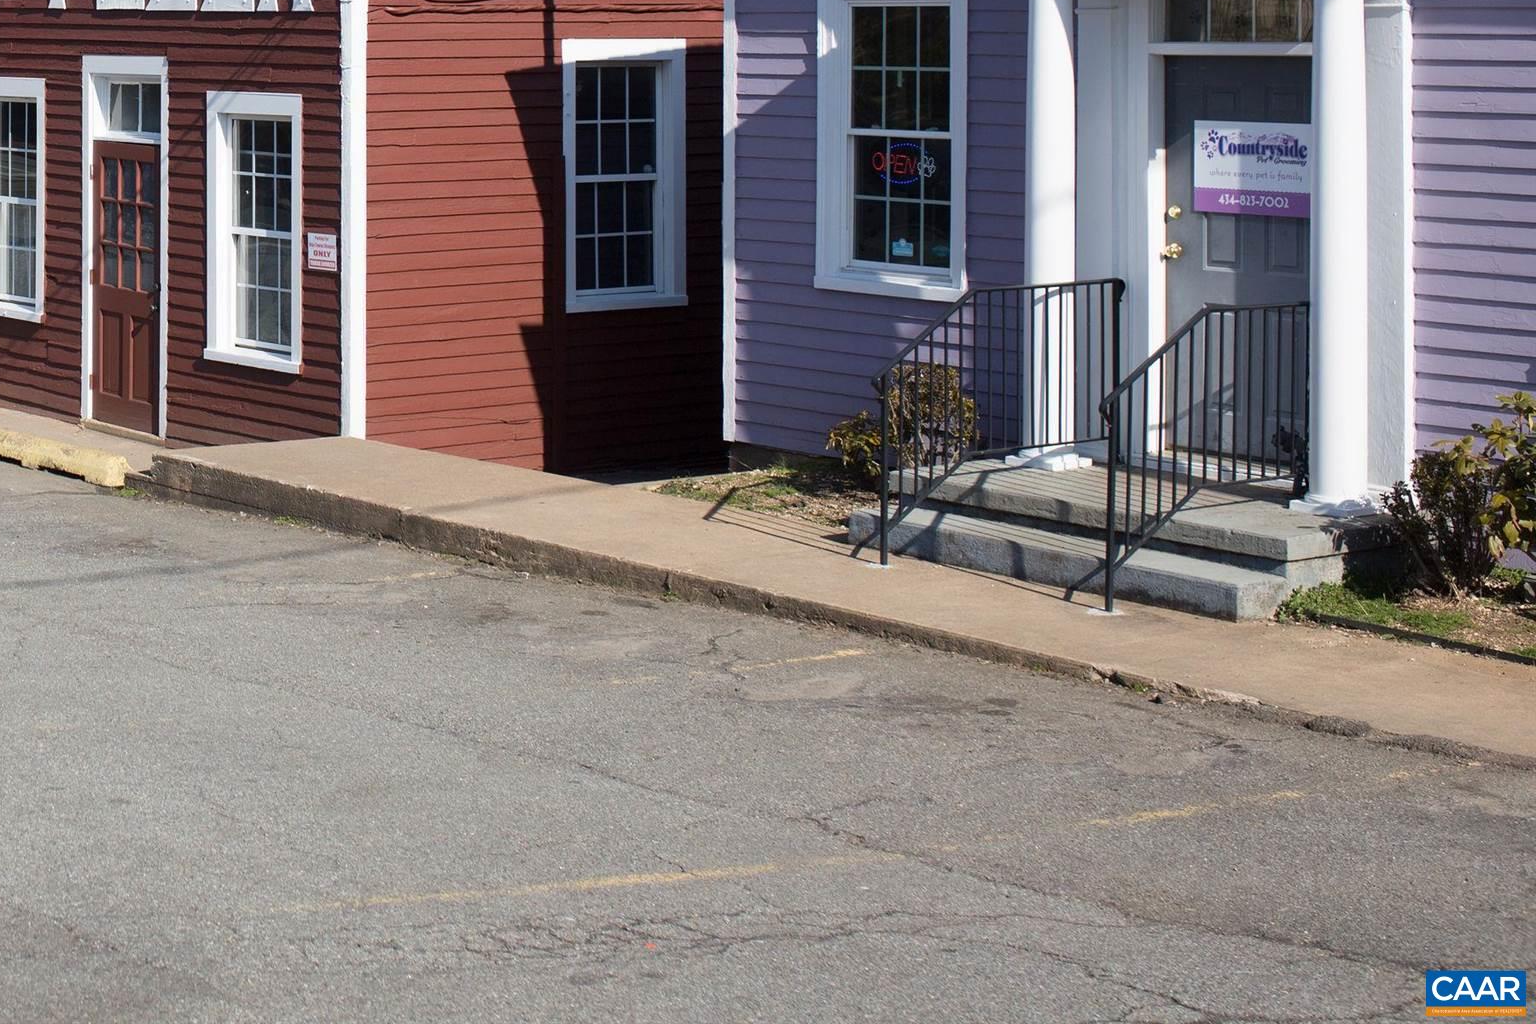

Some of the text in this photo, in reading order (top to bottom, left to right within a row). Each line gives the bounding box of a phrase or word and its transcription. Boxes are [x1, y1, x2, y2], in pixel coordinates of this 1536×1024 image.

[1218, 135, 1308, 160] Countryside
[872, 151, 918, 176] OPEN
[1256, 156, 1307, 167] Pet Grooming
[1209, 168, 1231, 177] where
[1233, 170, 1253, 180] every
[1255, 171, 1268, 182] pet
[1277, 170, 1303, 182] family
[1218, 194, 1290, 209] 434-823-7002
